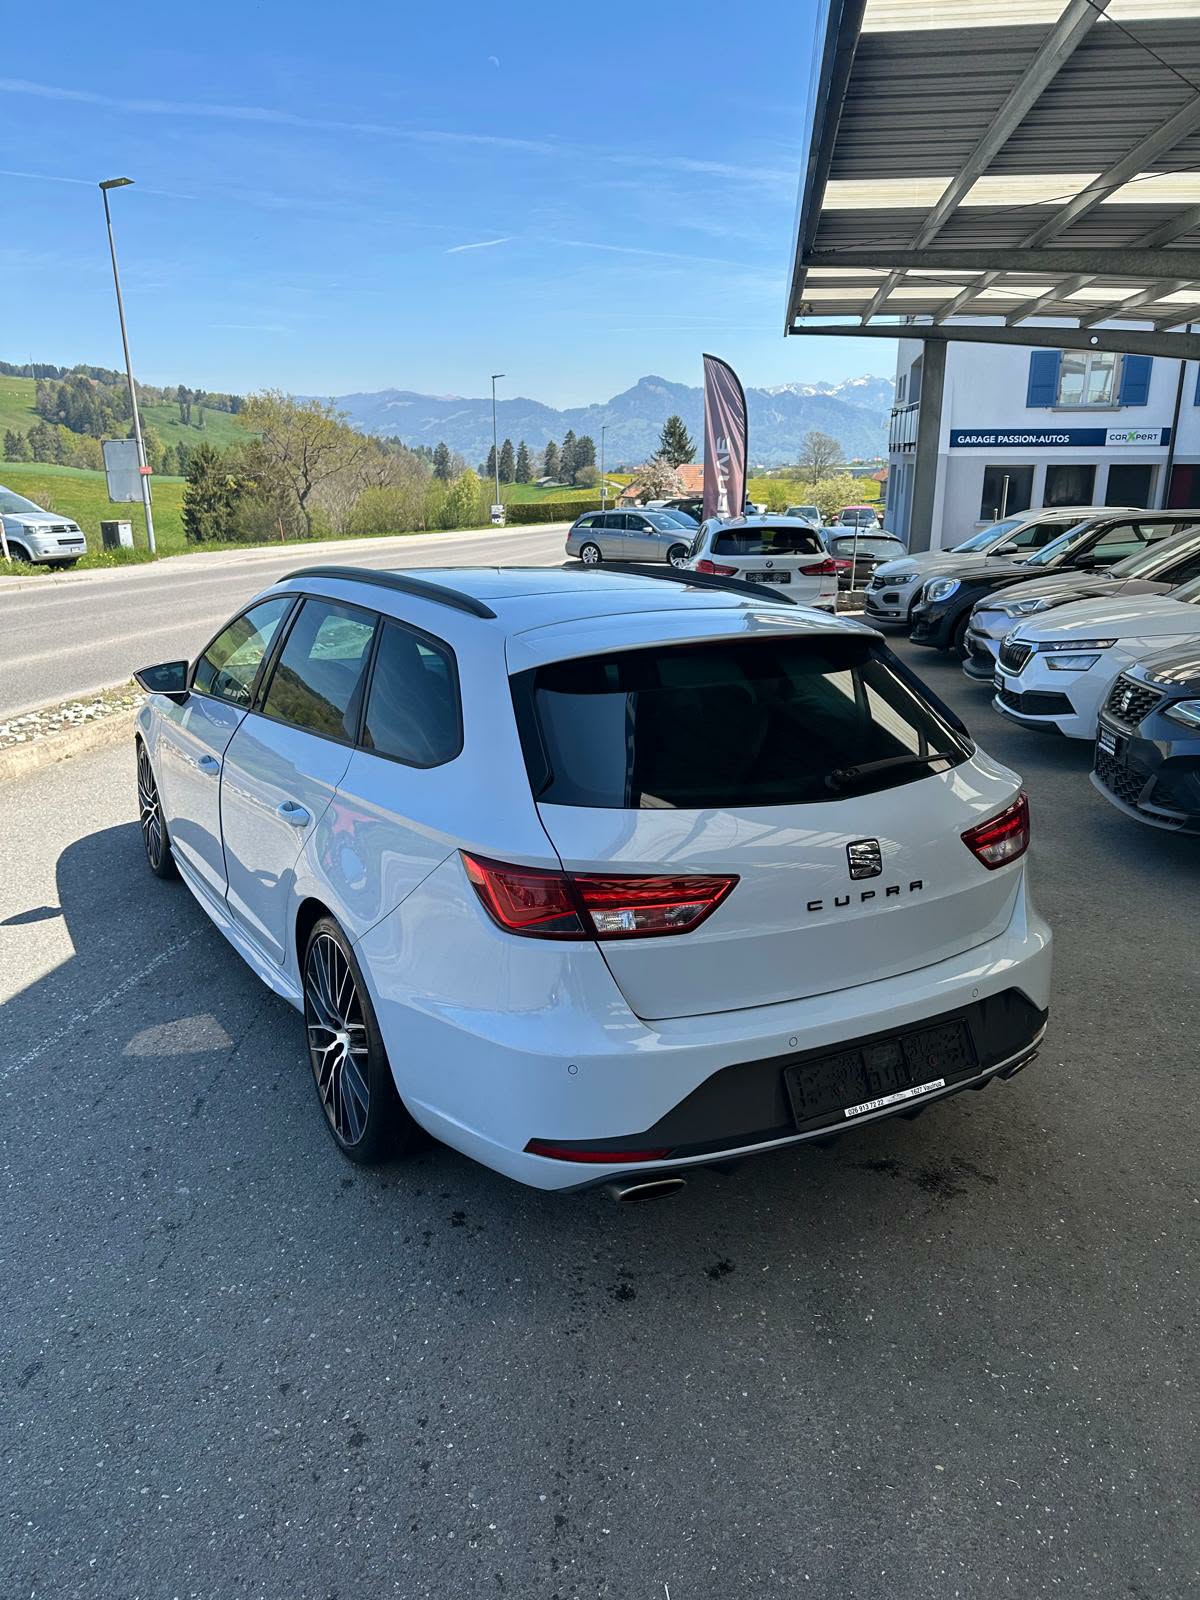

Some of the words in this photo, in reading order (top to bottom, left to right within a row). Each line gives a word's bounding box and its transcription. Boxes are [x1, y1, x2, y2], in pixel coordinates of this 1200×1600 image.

[957, 435, 996, 444] GARAGE
[997, 434, 1070, 443] PASSION-AUTOS
[807, 880, 923, 911] CUPRA
[847, 1107, 859, 1116] 026
[858, 1103, 870, 1112] 913
[910, 1087, 923, 1096] 1627
